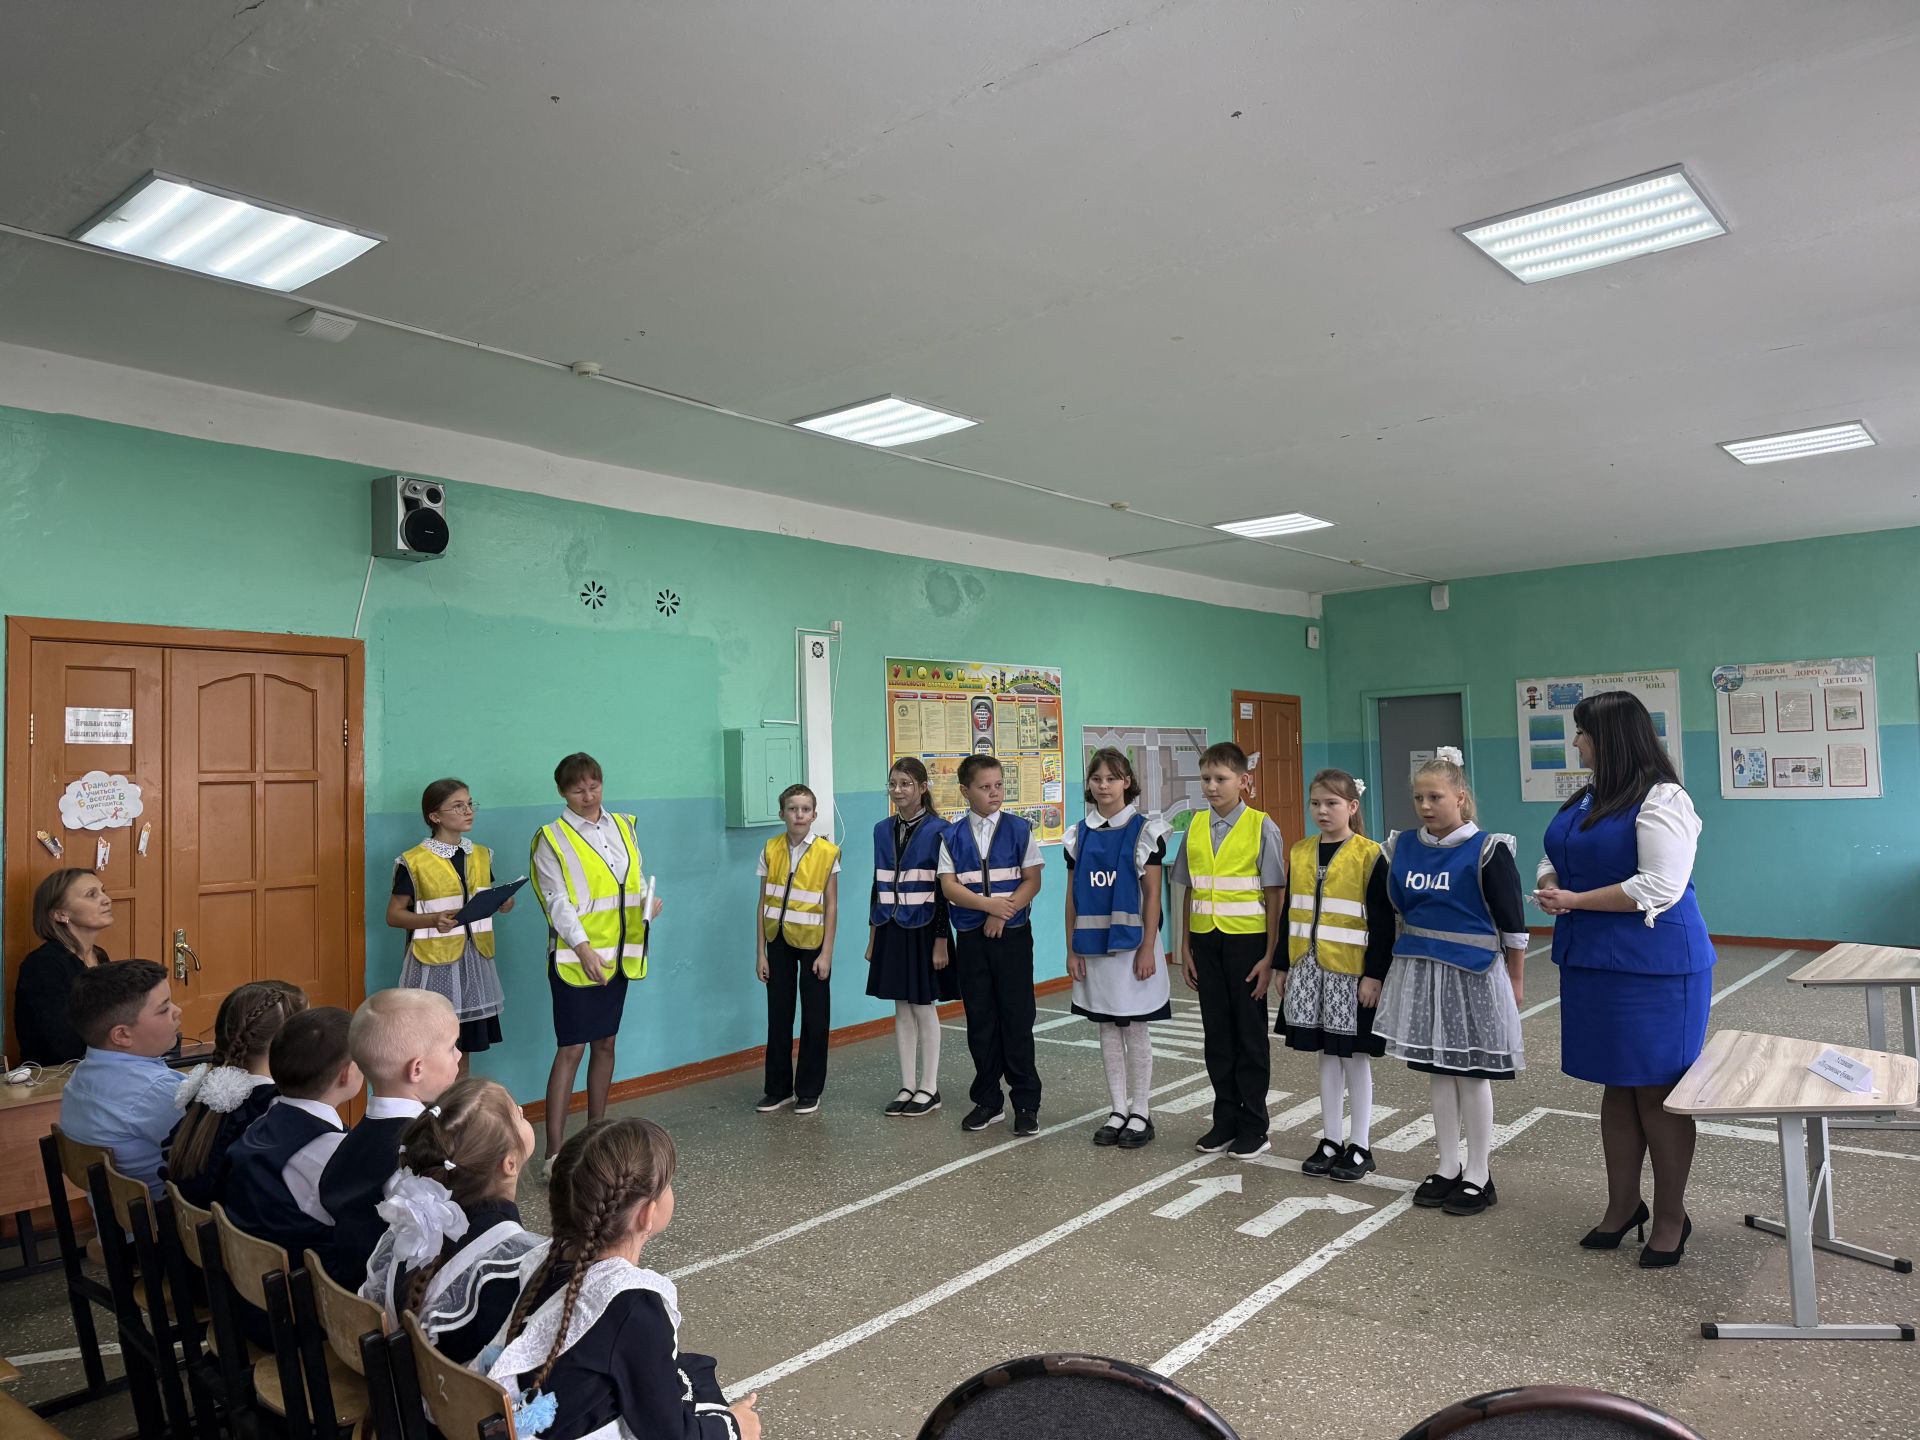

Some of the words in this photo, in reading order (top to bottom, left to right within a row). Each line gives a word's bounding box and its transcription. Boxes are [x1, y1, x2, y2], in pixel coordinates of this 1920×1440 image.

[1753, 668, 1786, 676] ДОБРАЯ
[1794, 669, 1828, 677] ДОРОГА
[1627, 675, 1659, 683] ОТРЯДА
[1824, 677, 1863, 685] ДЕТСТВА
[82, 781, 118, 791] Грамоте
[90, 794, 115, 802] всегда
[1090, 870, 1117, 887] ЮИ
[1405, 870, 1450, 891] ЮИД
